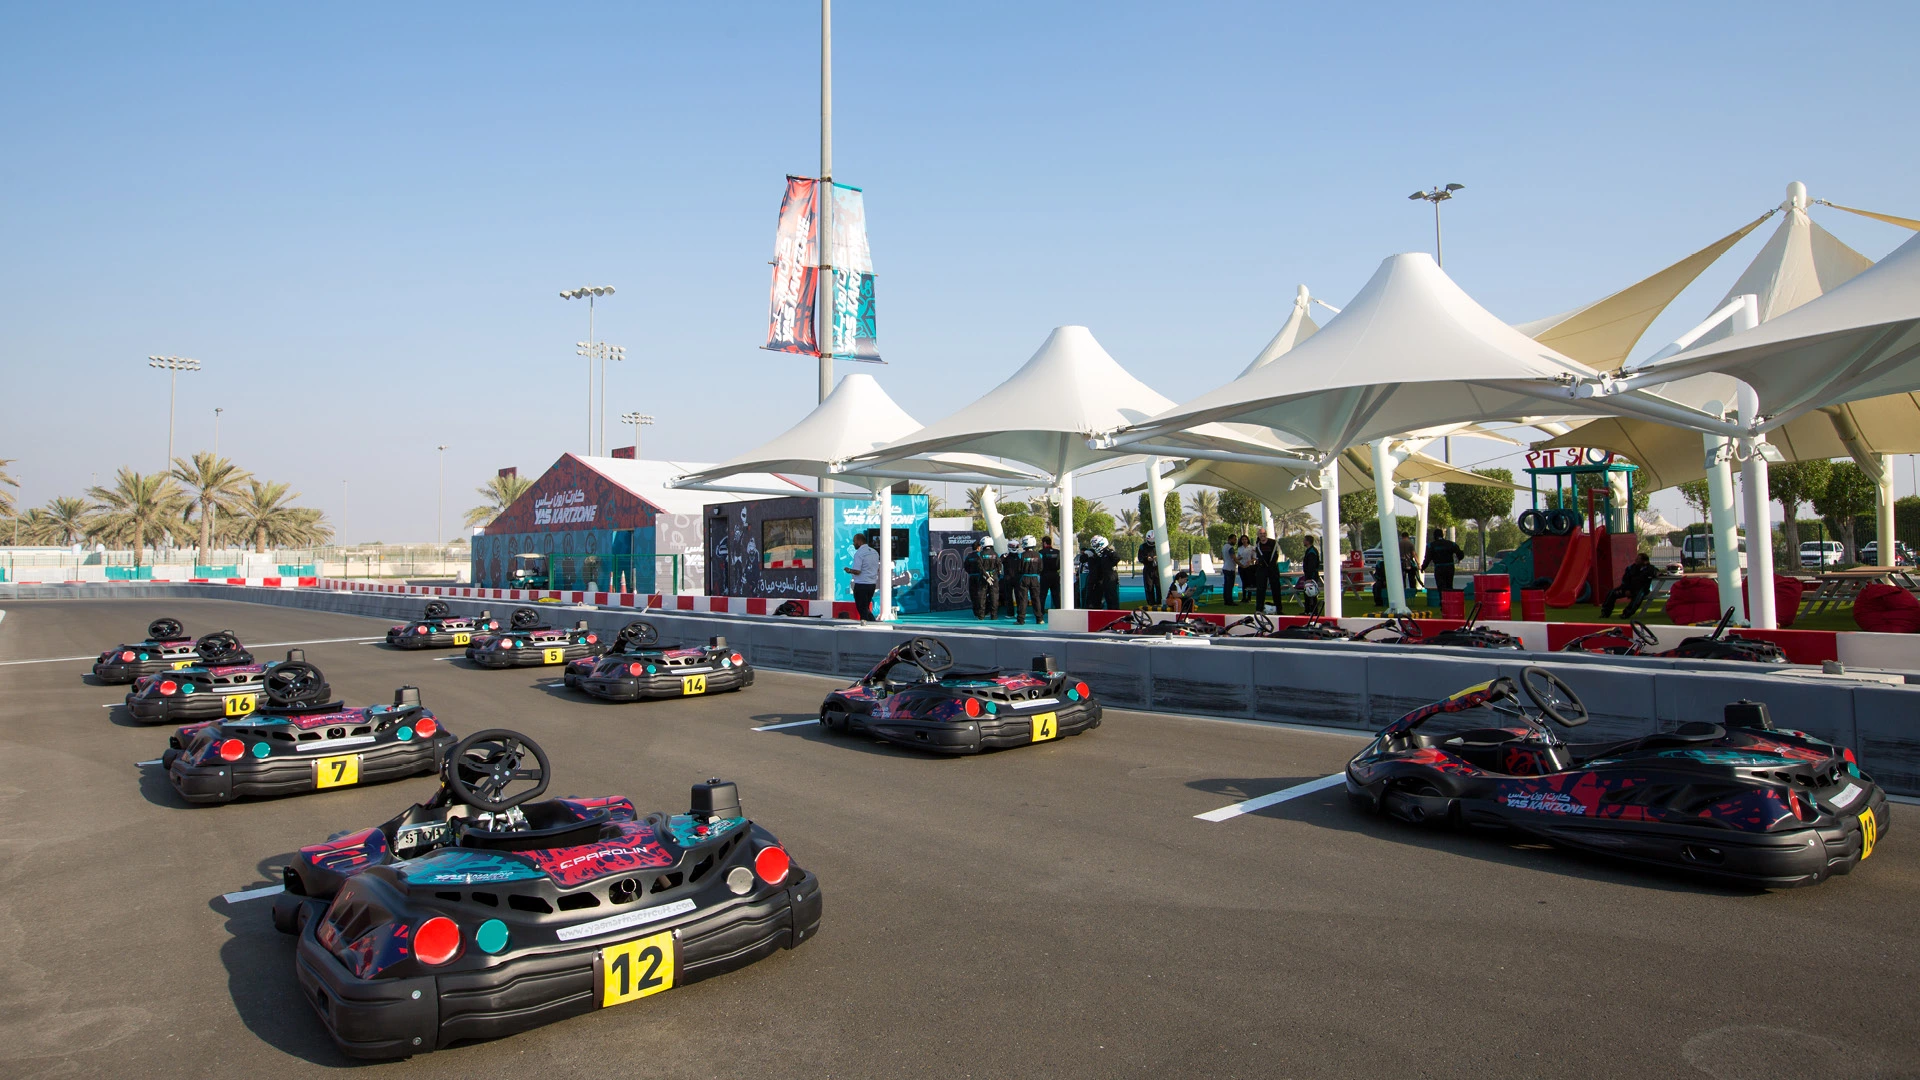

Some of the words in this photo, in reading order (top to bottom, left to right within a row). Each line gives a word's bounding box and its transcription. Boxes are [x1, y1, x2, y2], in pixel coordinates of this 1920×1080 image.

[535, 492, 554, 508] ياس
[553, 491, 567, 507] زون
[565, 489, 585, 506] كارت
[534, 508, 552, 525] YAS
[551, 505, 597, 524] KARTZONE
[844, 514, 866, 525] YAS
[865, 514, 916, 525] KAZONE
[456, 635, 468, 643] 10
[550, 651, 558, 661] 5
[687, 678, 703, 692] 14
[229, 697, 250, 713] 16
[1040, 719, 1050, 737] 4
[331, 760, 347, 782] 7
[1507, 798, 1529, 809] YAS
[1528, 800, 1587, 815] KARTZONE
[405, 827, 441, 844] STOP
[1864, 815, 1875, 852] 13
[612, 945, 663, 997] 12
